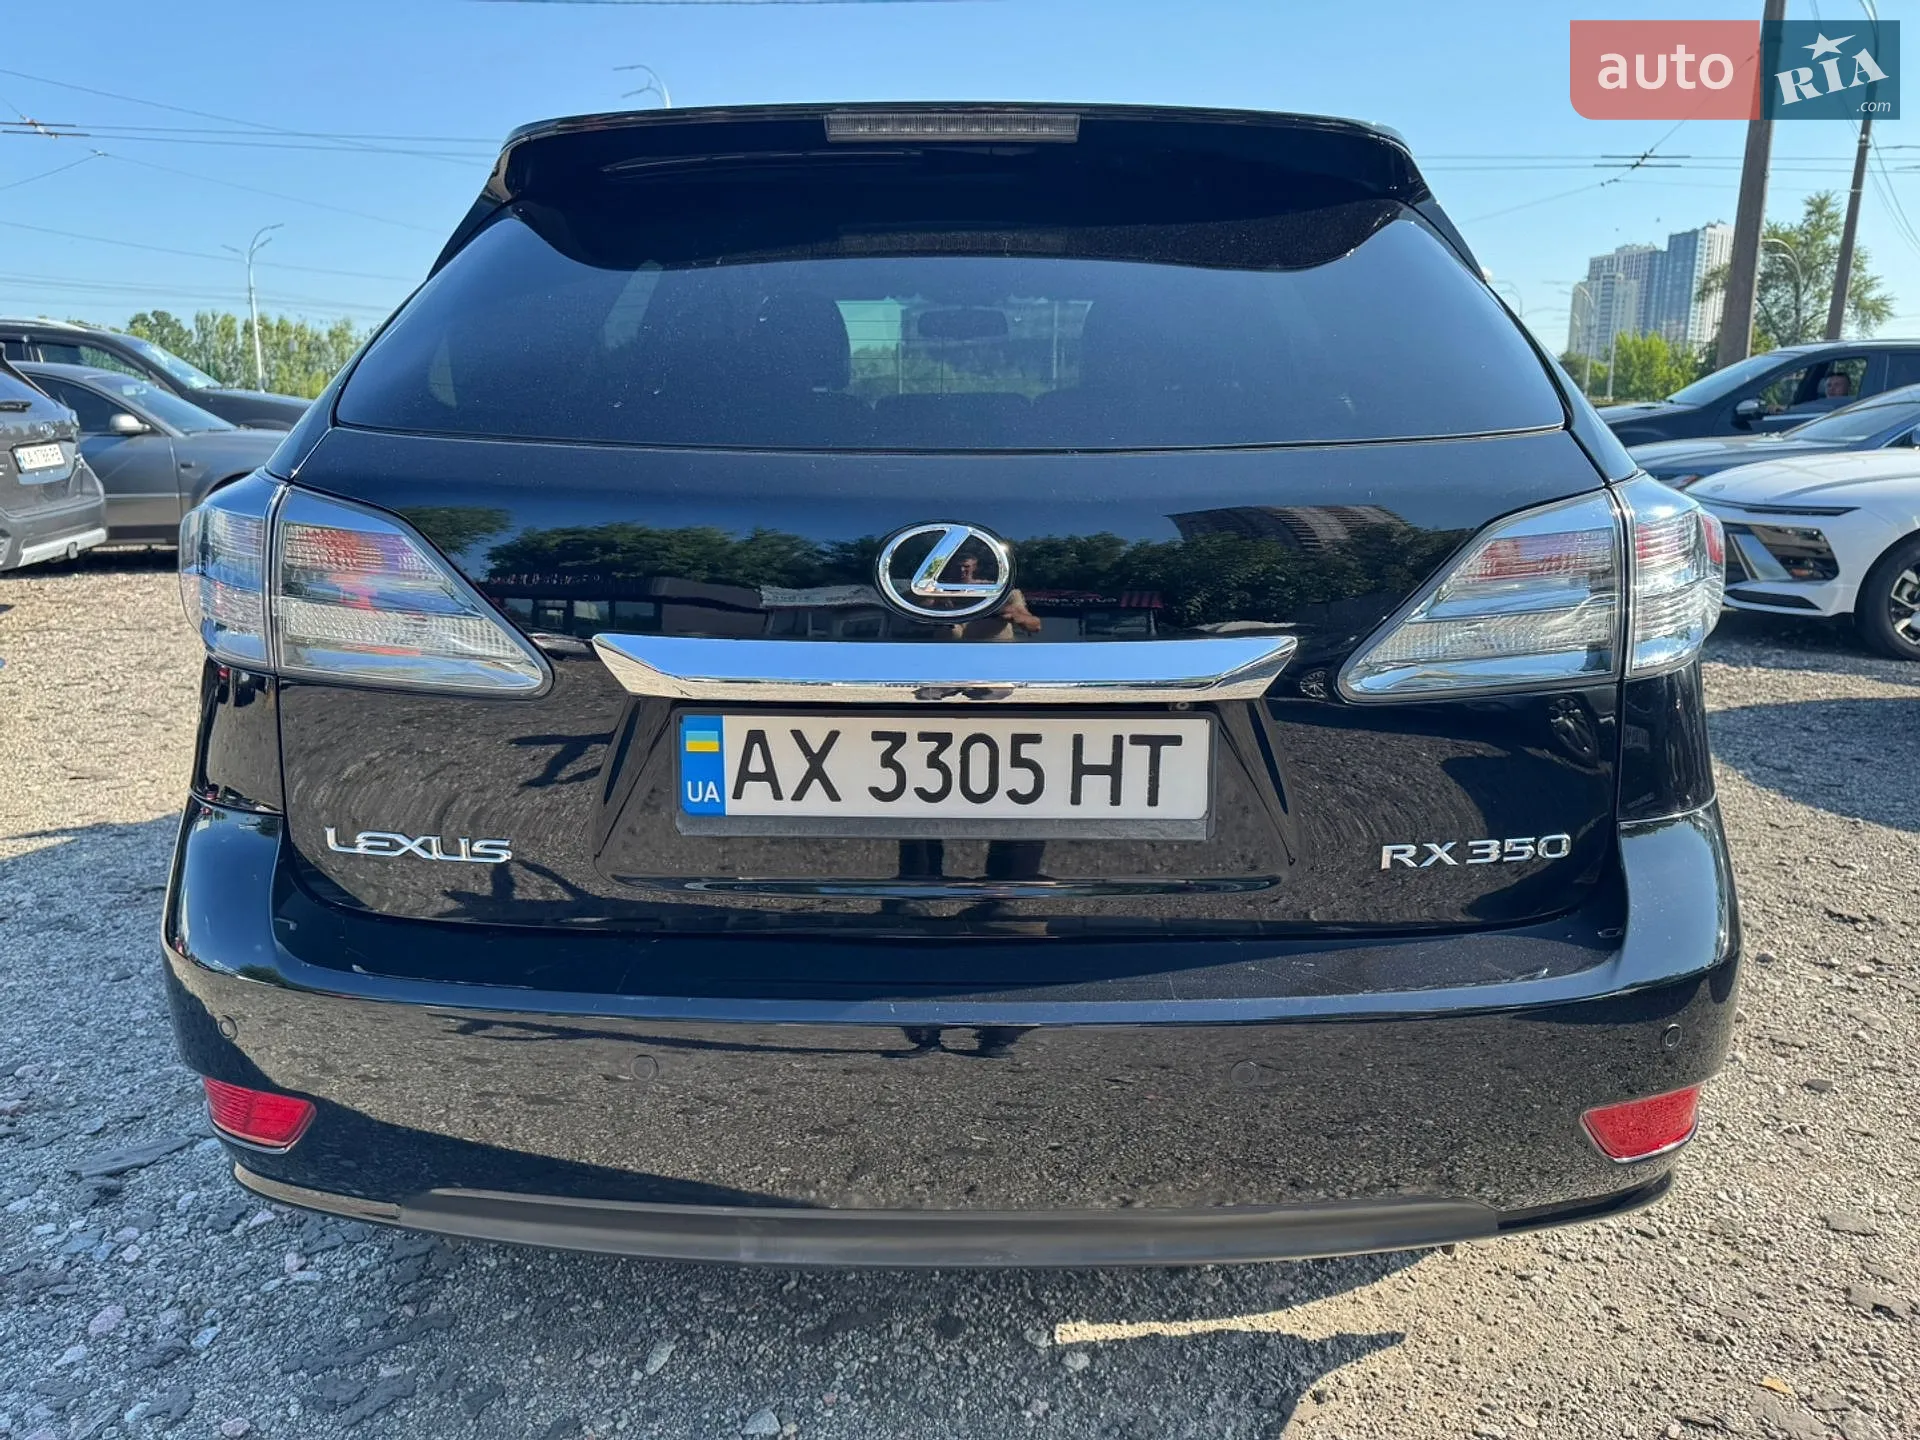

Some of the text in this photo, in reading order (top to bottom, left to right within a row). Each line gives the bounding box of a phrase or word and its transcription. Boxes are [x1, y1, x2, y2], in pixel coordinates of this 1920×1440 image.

[731, 729, 1183, 807] AX 3305 HT
[687, 780, 721, 803] UA
[324, 826, 513, 864] LEXUS
[1380, 831, 1572, 870] RX 350
